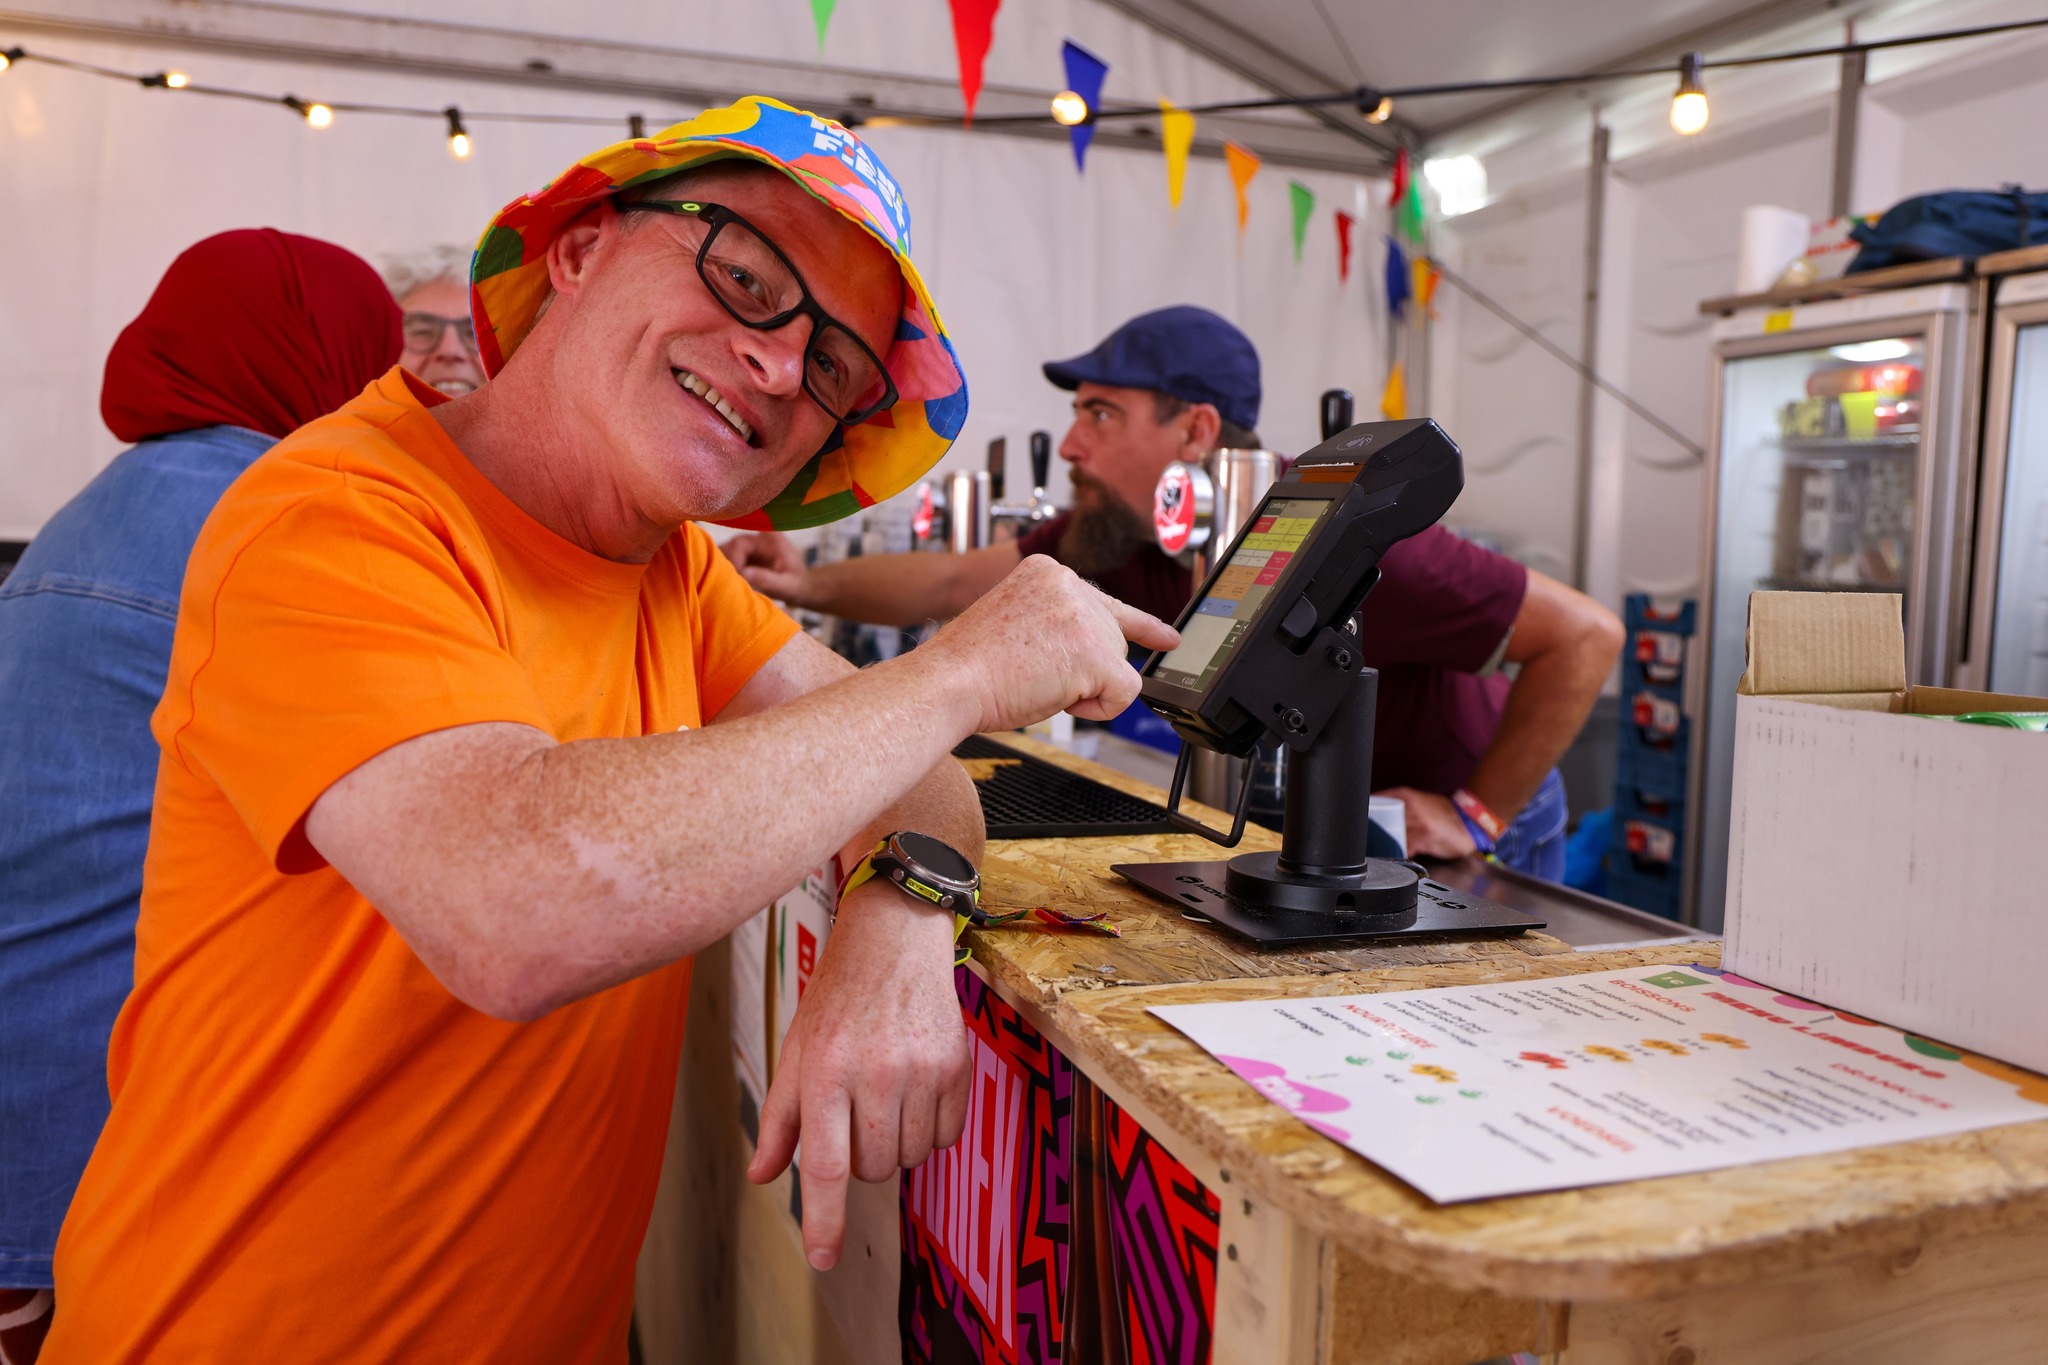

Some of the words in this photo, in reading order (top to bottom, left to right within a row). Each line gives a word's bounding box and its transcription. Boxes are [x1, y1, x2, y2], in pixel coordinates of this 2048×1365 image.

[1609, 979, 1697, 1012] BOISSONS
[1702, 991, 1794, 1024] MENU
[1311, 1006, 1342, 1021] Burger
[1343, 1004, 1436, 1049] NOURRITURE
[913, 1026, 1023, 1349] RIEK
